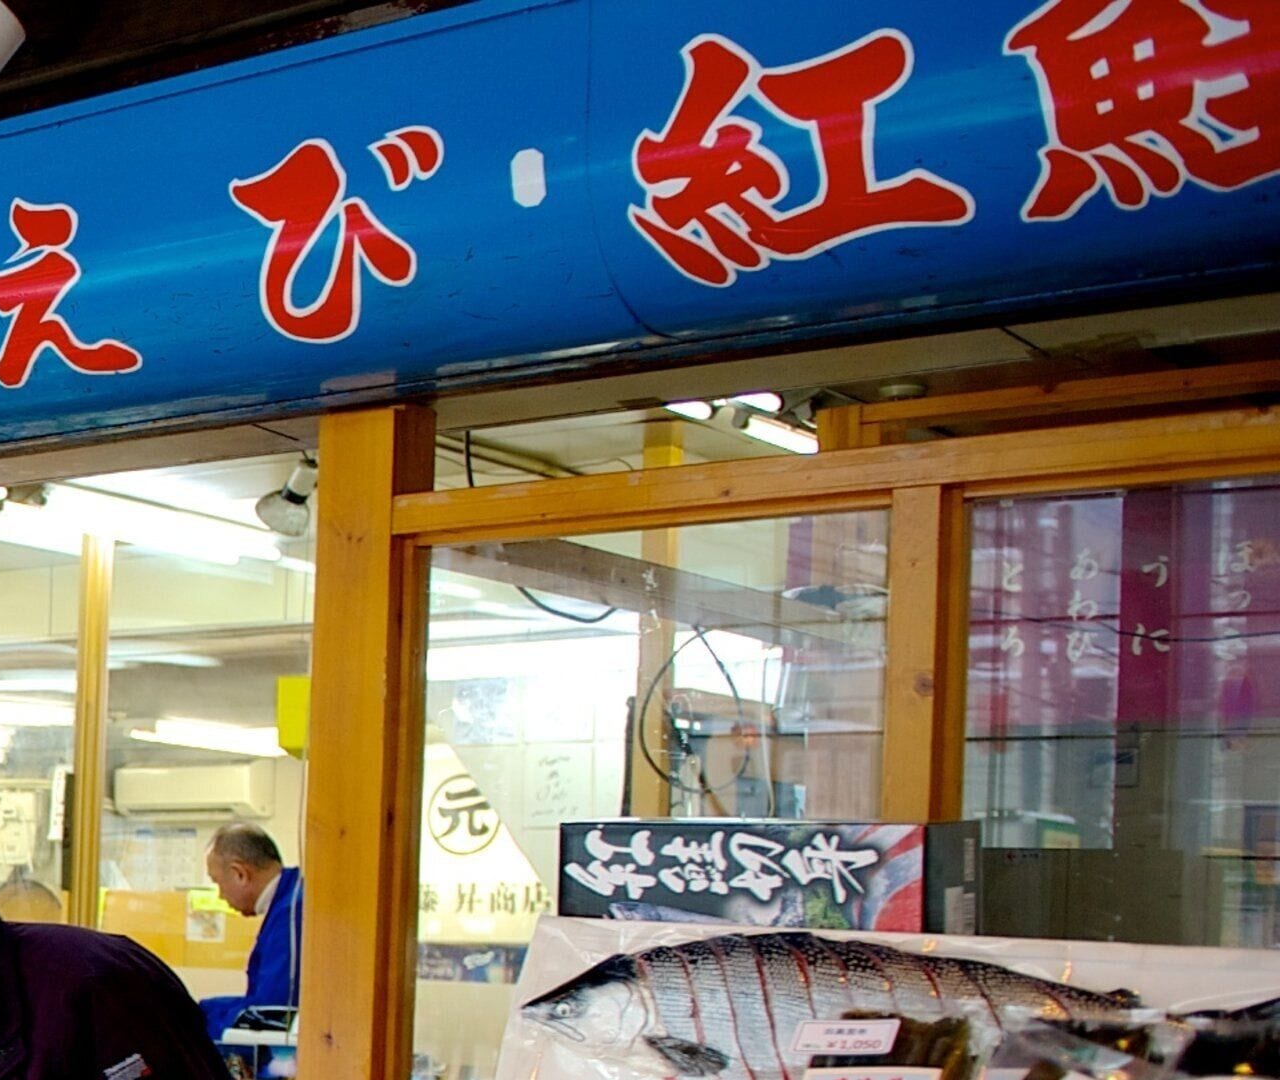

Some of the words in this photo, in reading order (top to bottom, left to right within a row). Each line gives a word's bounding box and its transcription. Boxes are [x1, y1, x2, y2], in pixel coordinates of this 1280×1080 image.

[1066, 548, 1100, 663] あわび
[438, 788, 491, 838] 元
[562, 826, 881, 904] 紅鮭切身
